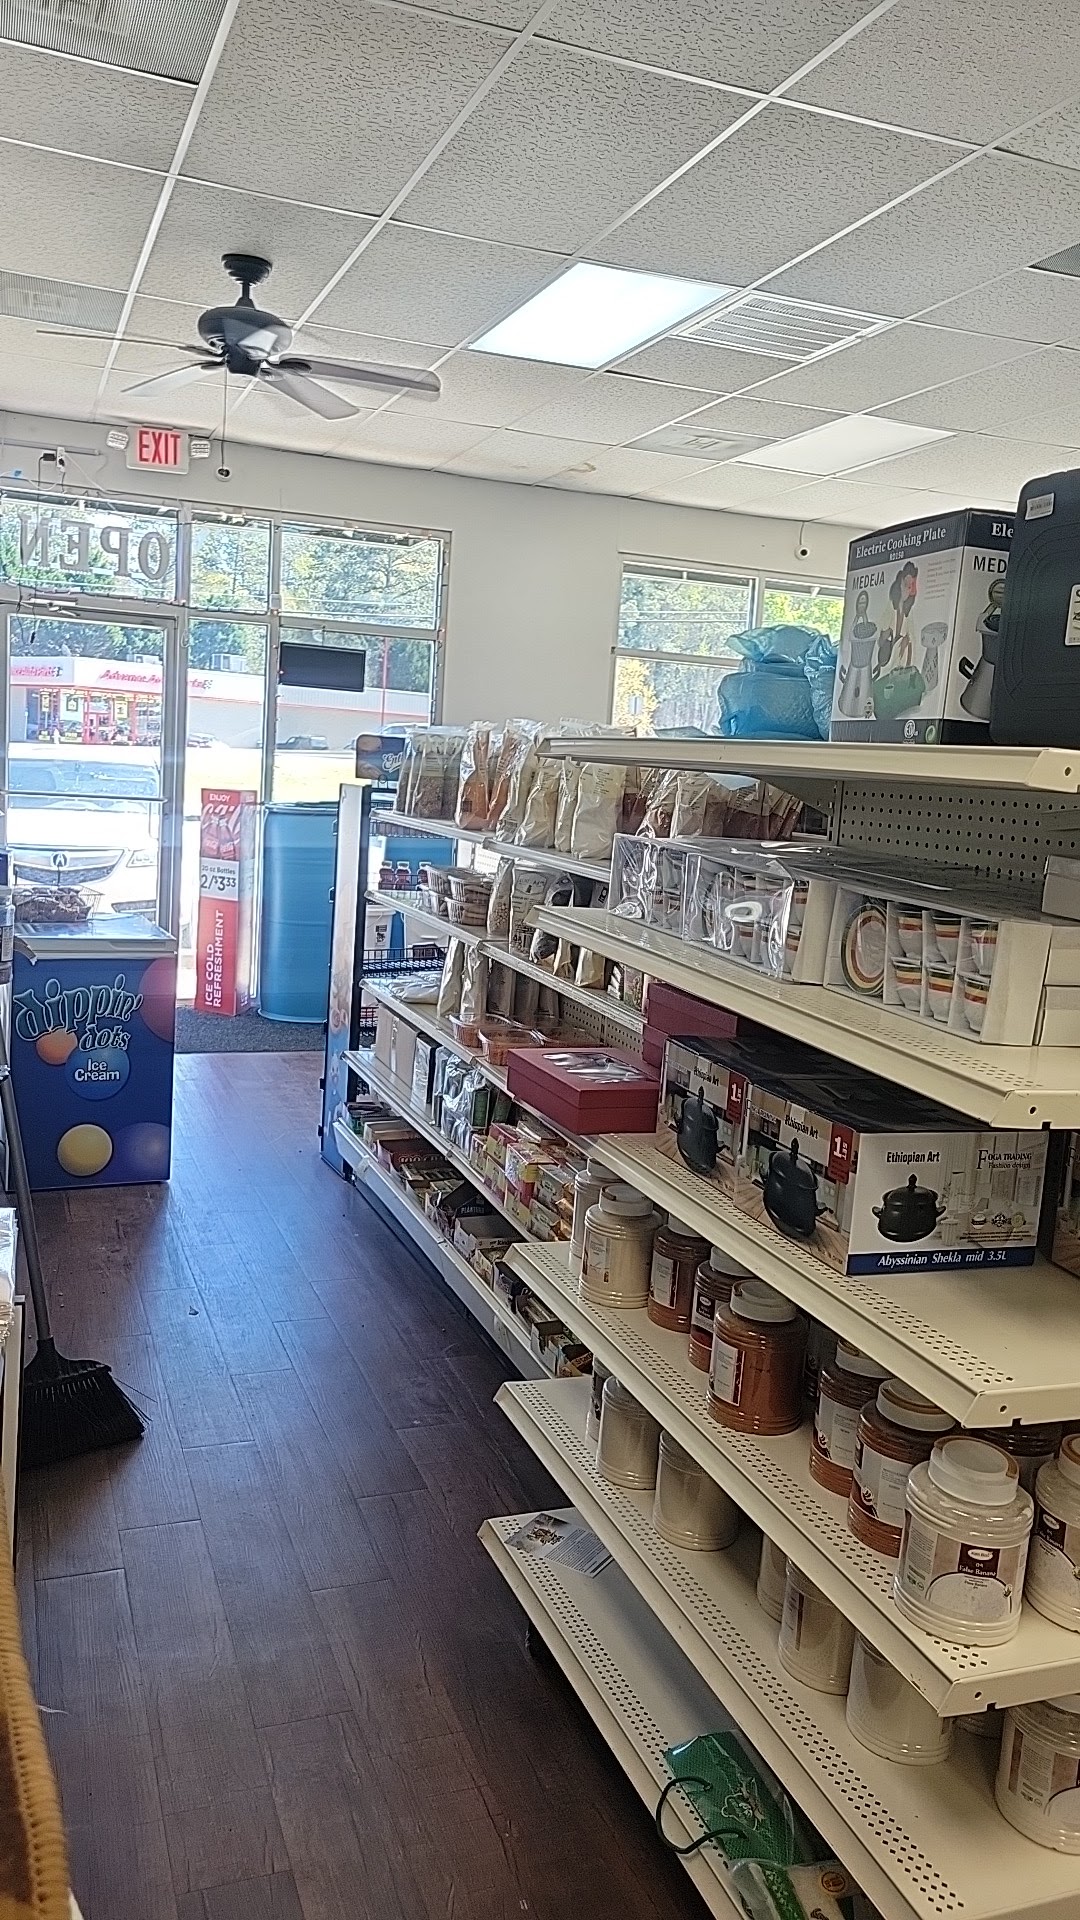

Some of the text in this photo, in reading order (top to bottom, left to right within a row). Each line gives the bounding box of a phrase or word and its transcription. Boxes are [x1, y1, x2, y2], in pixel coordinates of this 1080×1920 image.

[138, 430, 181, 466] EXIT
[856, 527, 947, 558] Electric Cooking Plate
[852, 571, 885, 590] MEDEJA
[209, 793, 231, 803] ENJOY
[216, 866, 236, 875] Bottles
[213, 909, 224, 1008] REFRESHMENT
[205, 943, 215, 1006] ICE COLD
[78, 1024, 132, 1051] dots
[86, 1058, 108, 1071] Ice
[74, 1068, 120, 1082] Cream
[784, 1114, 819, 1140] Ethiopian Art
[886, 1150, 940, 1165] Ethiopian Art
[988, 1160, 1031, 1170] Fashion design
[1002, 1152, 1032, 1161] TRADING
[877, 1250, 1007, 1269] Abyssinian Shekla mid 3.5L
[959, 1565, 974, 1574] False
[975, 1569, 997, 1577] Banana
